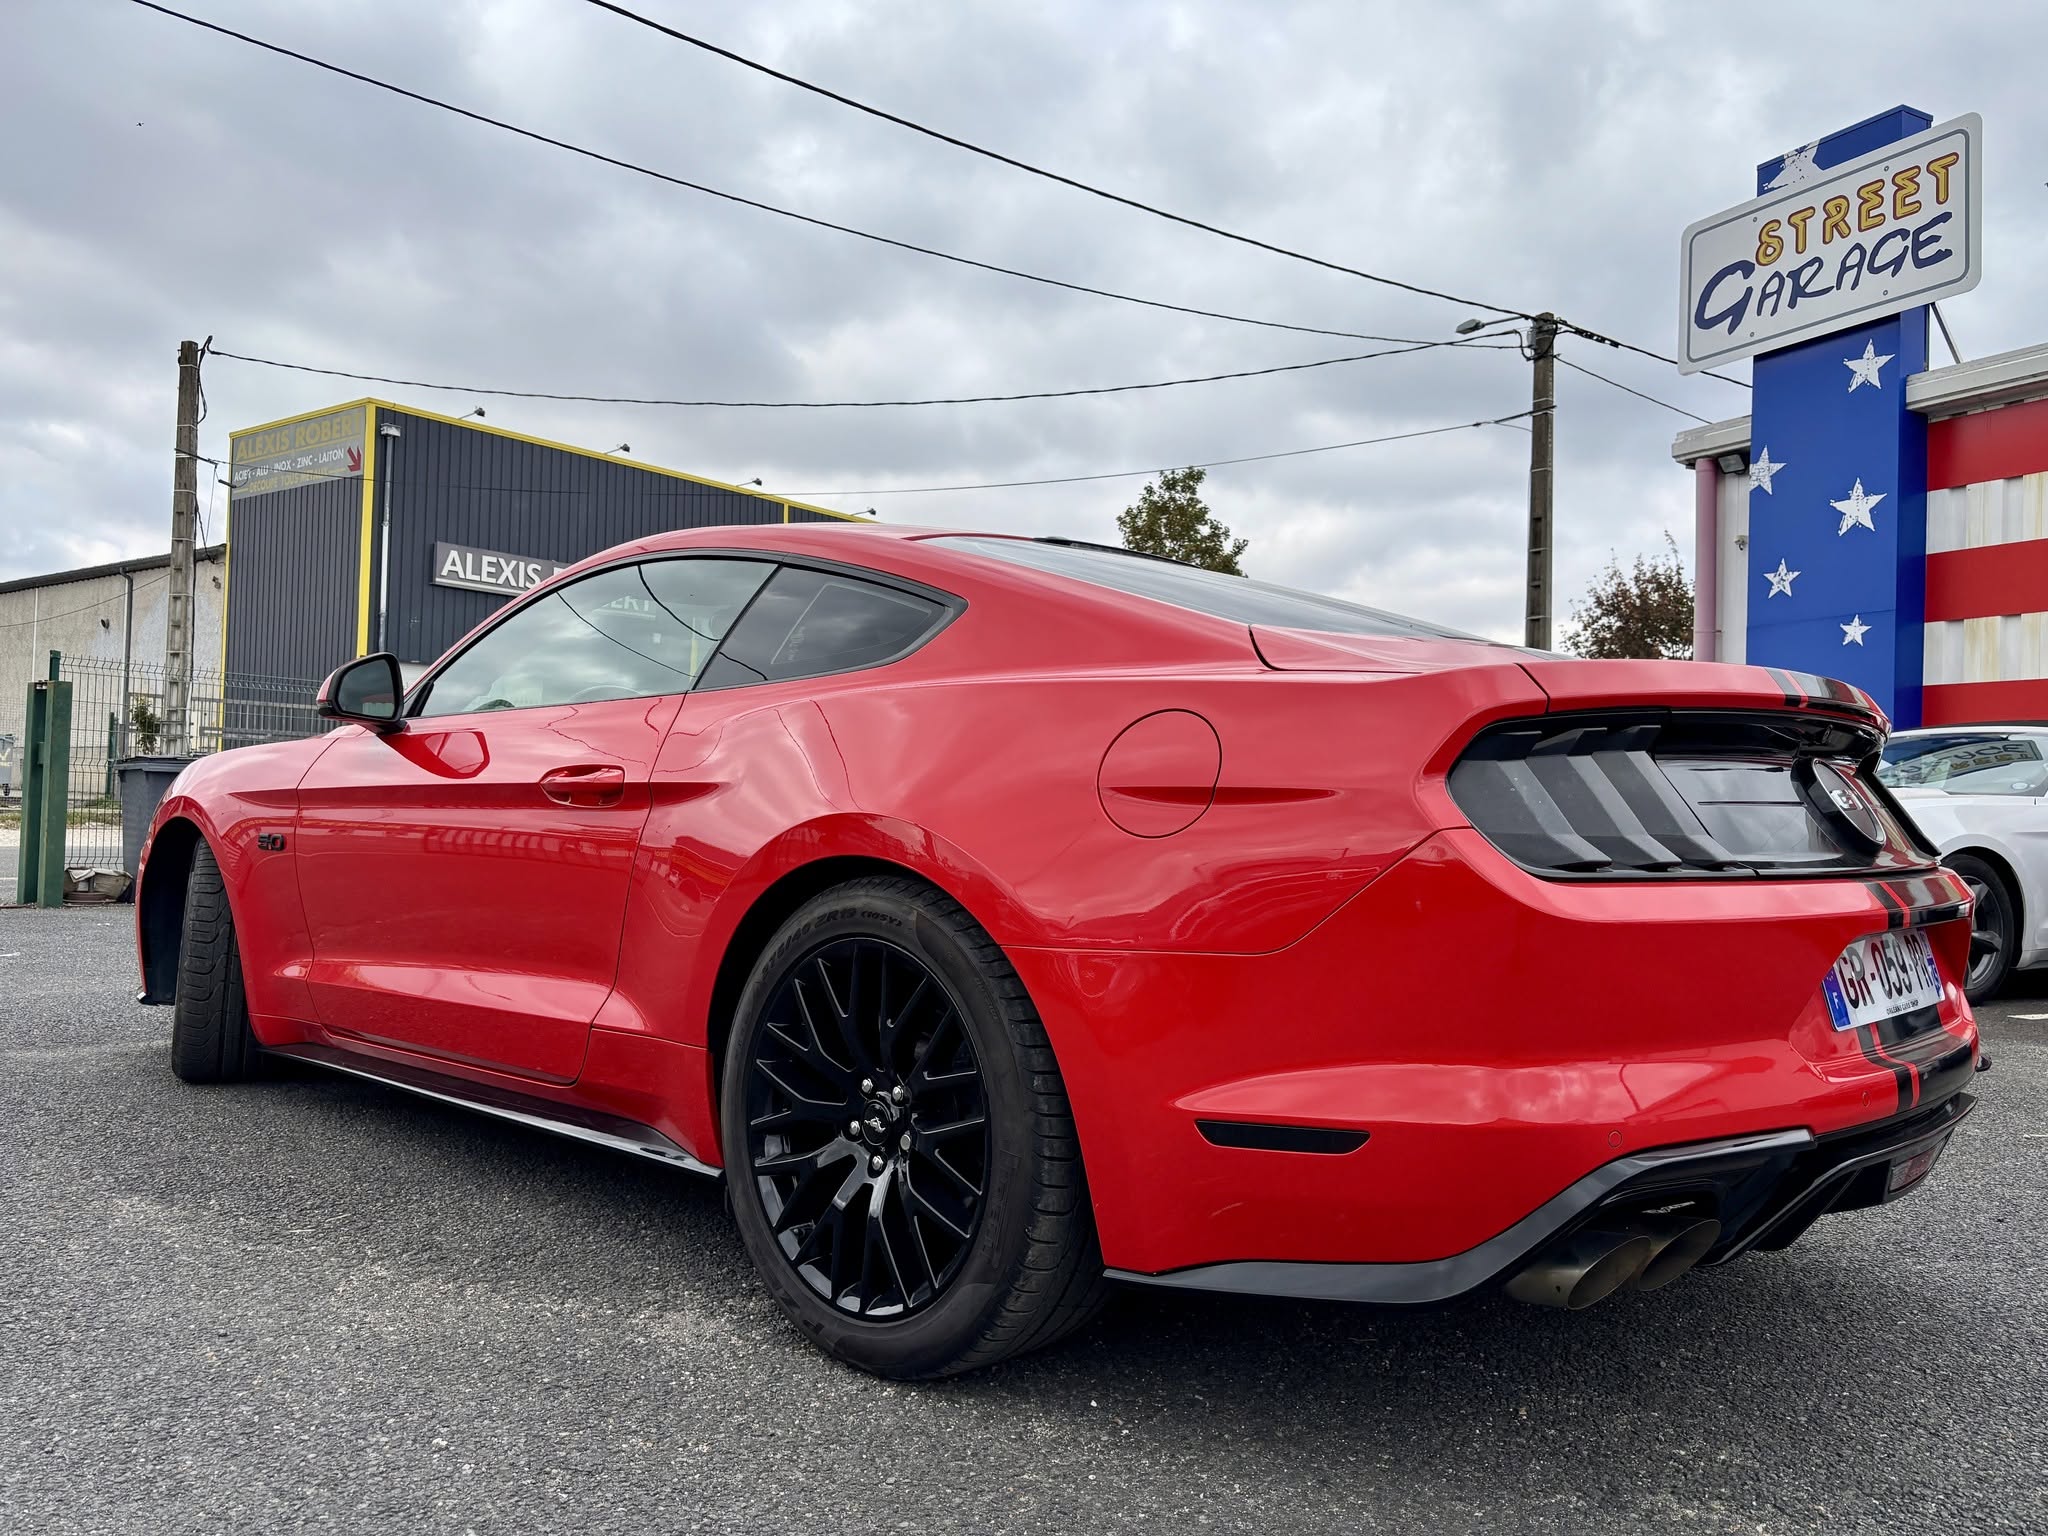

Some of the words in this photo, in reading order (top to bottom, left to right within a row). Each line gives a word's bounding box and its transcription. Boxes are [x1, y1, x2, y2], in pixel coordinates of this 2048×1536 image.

[1755, 152, 1960, 266] STREET
[1694, 211, 1953, 335] GARAGE
[236, 430, 290, 460] ALEXIS
[295, 412, 362, 447] ROBERT
[255, 464, 269, 477] ALU
[274, 459, 292, 473] INOX
[297, 454, 313, 468] ZINC
[318, 448, 345, 463] LAITON
[441, 550, 542, 589] ALEXIS
[1832, 991, 1839, 1009] F
